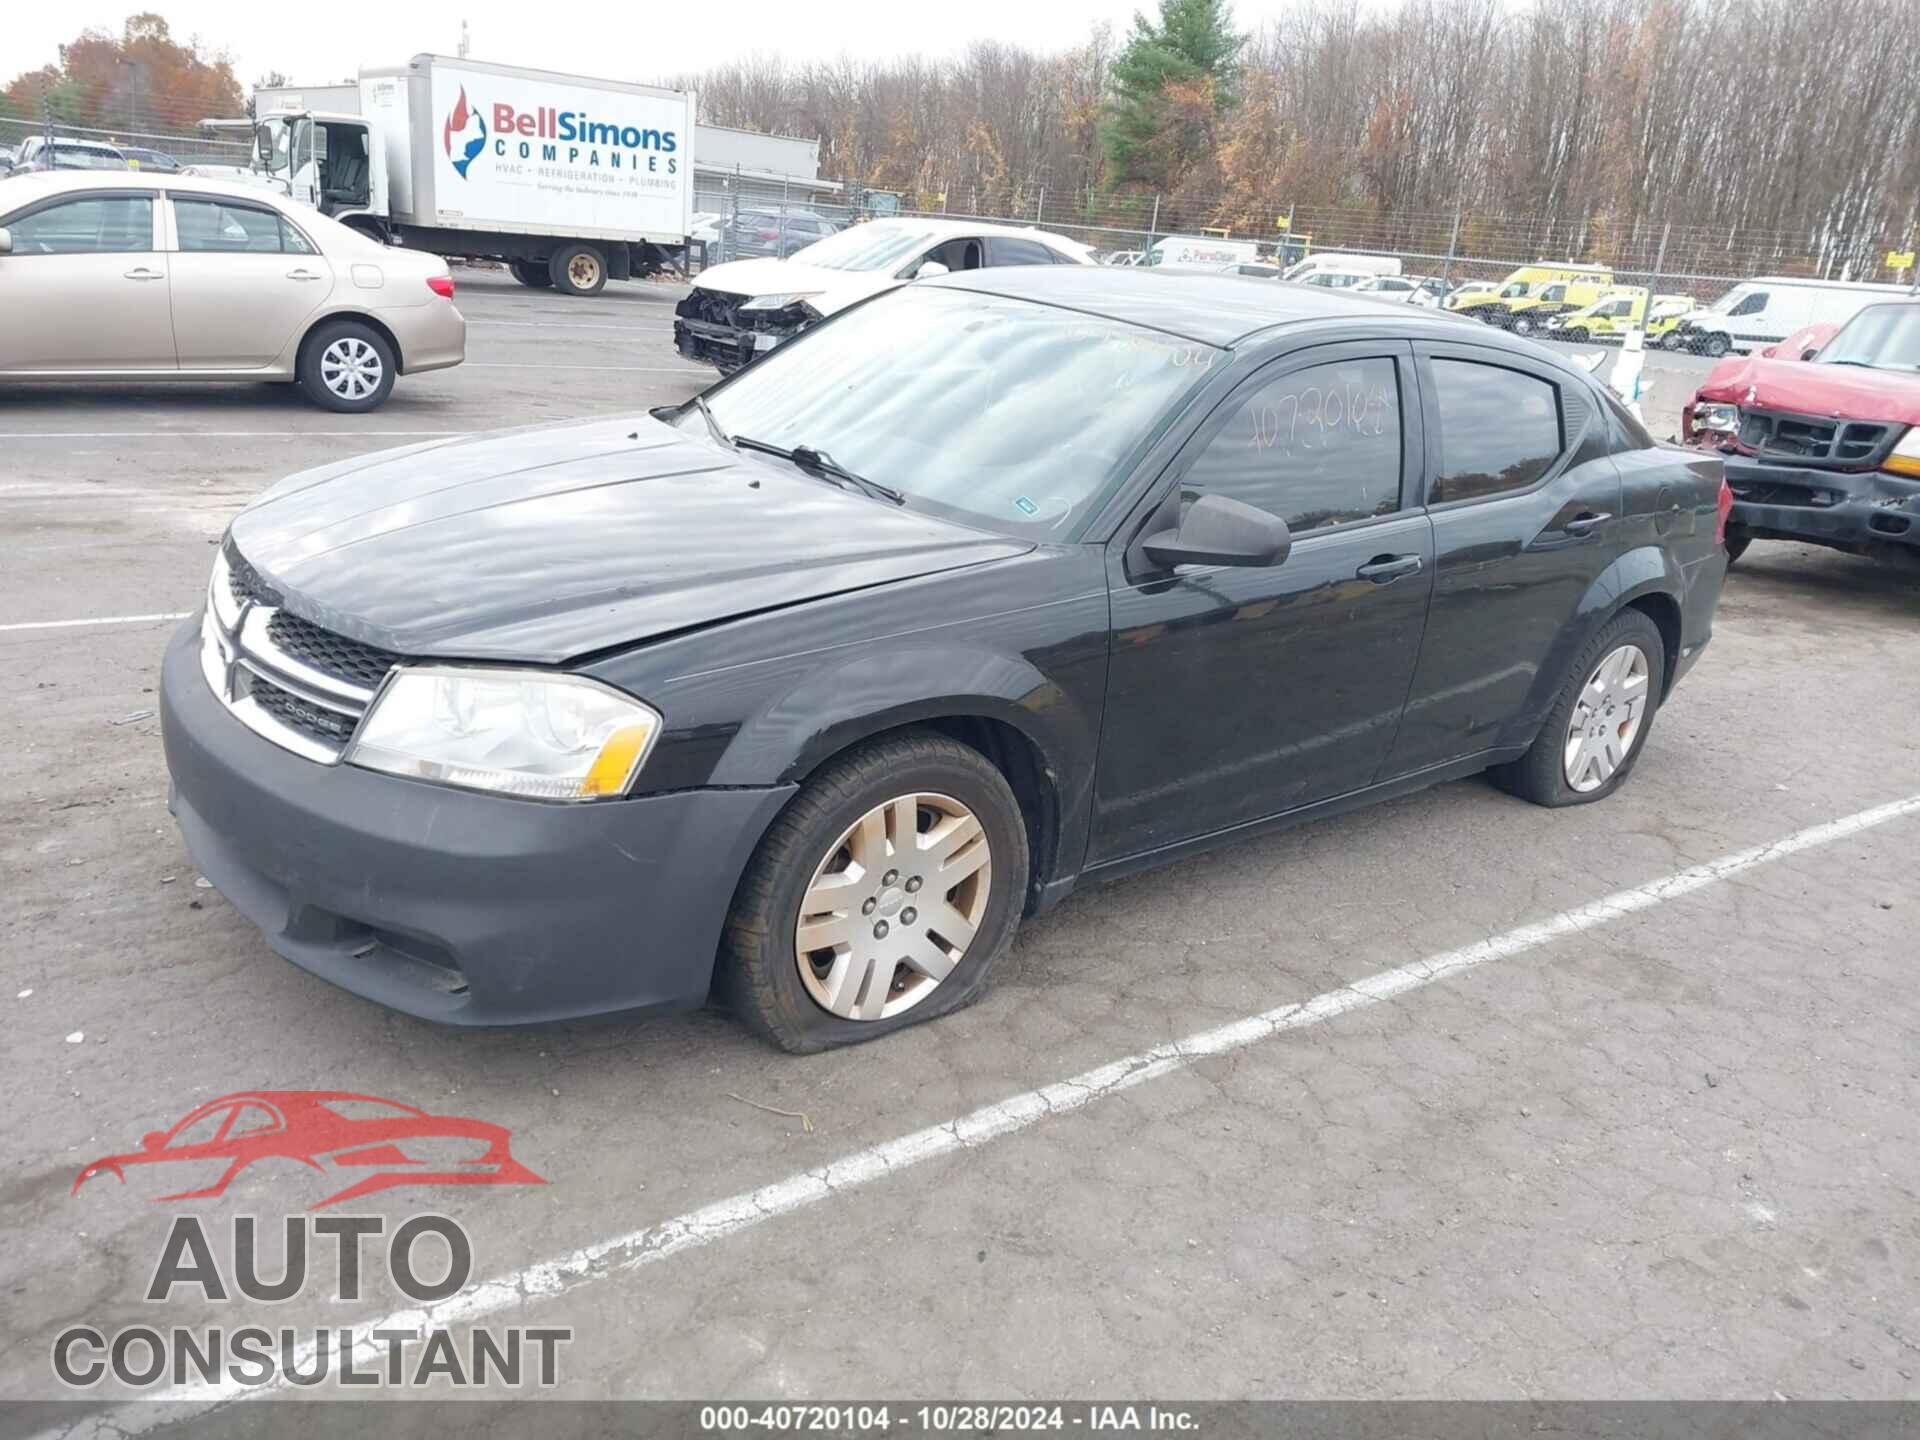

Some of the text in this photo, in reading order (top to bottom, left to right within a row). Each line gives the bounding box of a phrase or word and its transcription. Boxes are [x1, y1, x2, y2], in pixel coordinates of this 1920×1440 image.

[493, 103, 677, 152] BellSimons
[496, 139, 677, 174] COMPANIES
[496, 164, 677, 190] HVAC REFRIGERATION PLUMBING
[285, 702, 341, 733] DODGE
